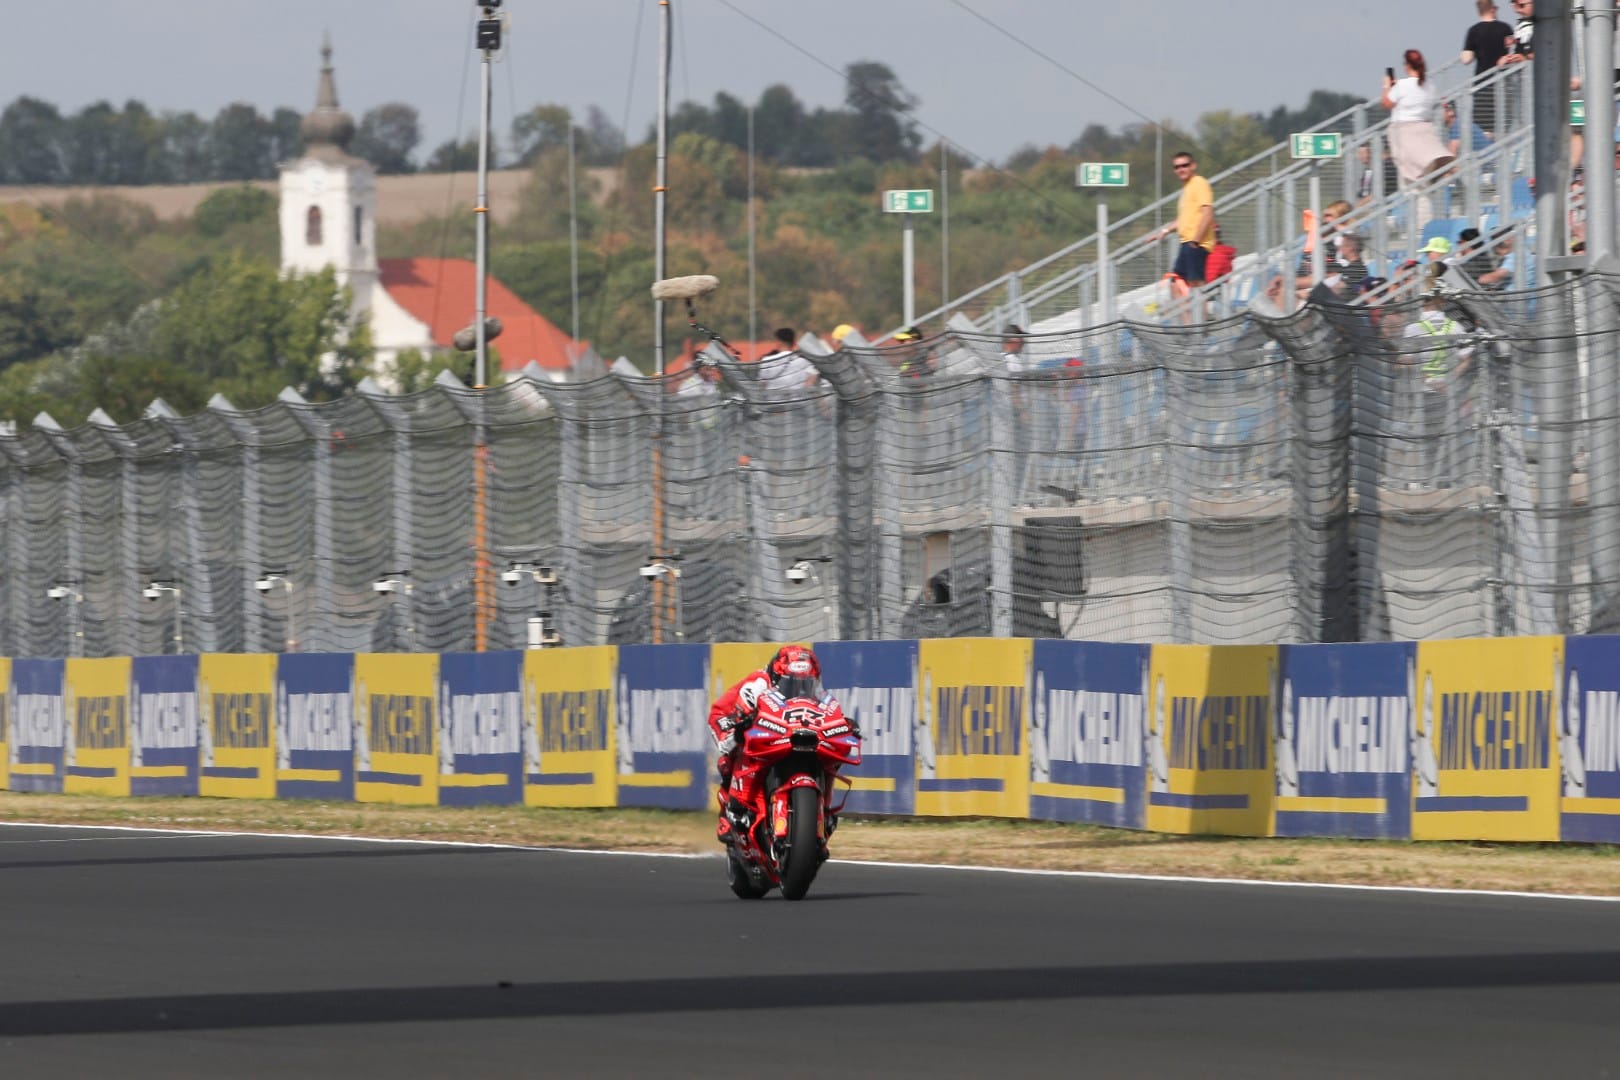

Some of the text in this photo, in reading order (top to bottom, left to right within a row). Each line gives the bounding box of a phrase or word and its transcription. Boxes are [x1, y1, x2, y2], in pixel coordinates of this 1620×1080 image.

[758, 718, 787, 734] Lenovo
[823, 725, 849, 737] Lenovo
[1049, 689, 1142, 766] MICHELIN
[1298, 695, 1408, 773] MICHELIN
[1441, 690, 1551, 770] MICHELIN
